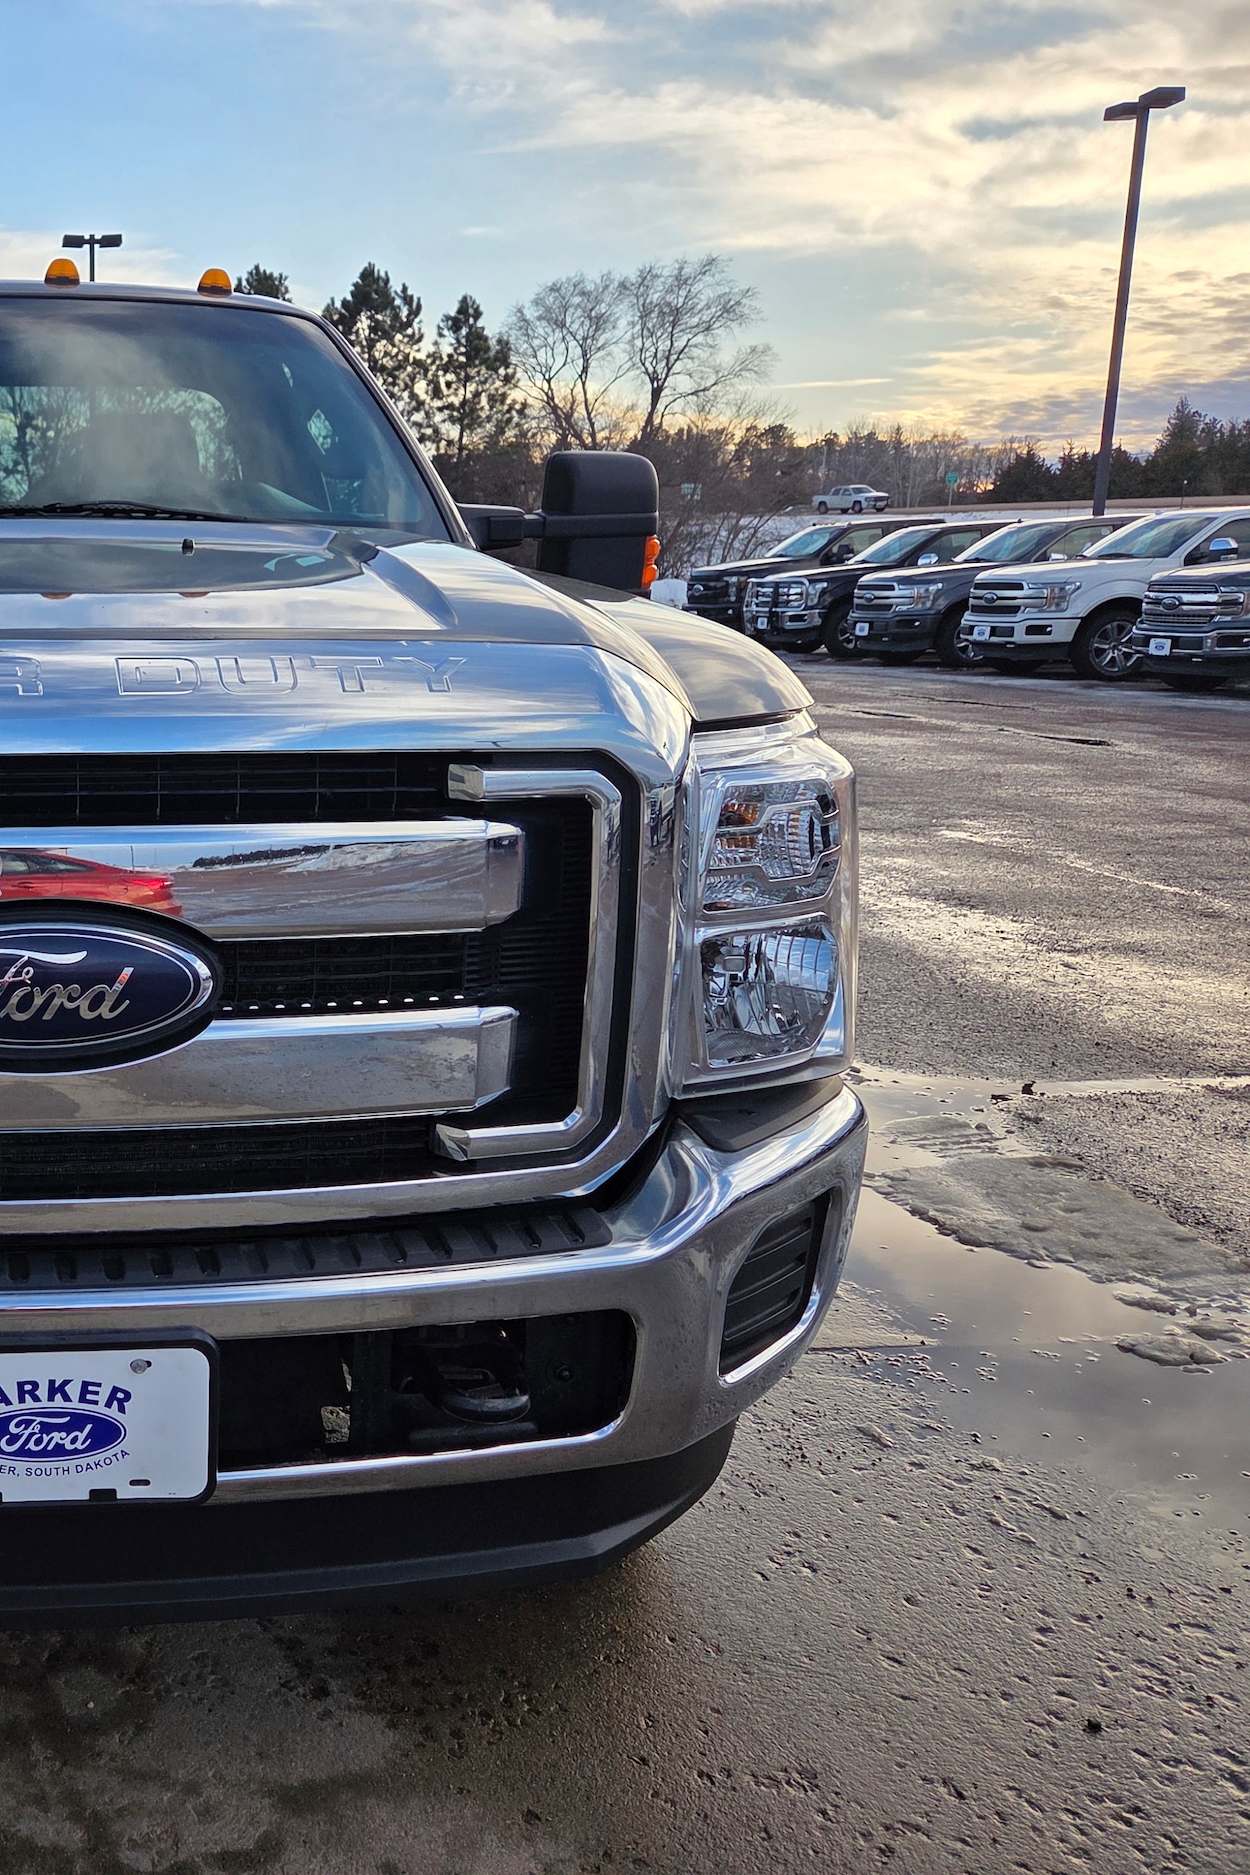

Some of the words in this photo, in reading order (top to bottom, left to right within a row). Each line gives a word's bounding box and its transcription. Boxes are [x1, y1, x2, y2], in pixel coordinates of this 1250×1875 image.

[114, 655, 468, 696] DUTY
[0, 1416, 93, 1452] Ford
[25, 1466, 71, 1477] SOUTH
[75, 1449, 130, 1474] DAKOTA
